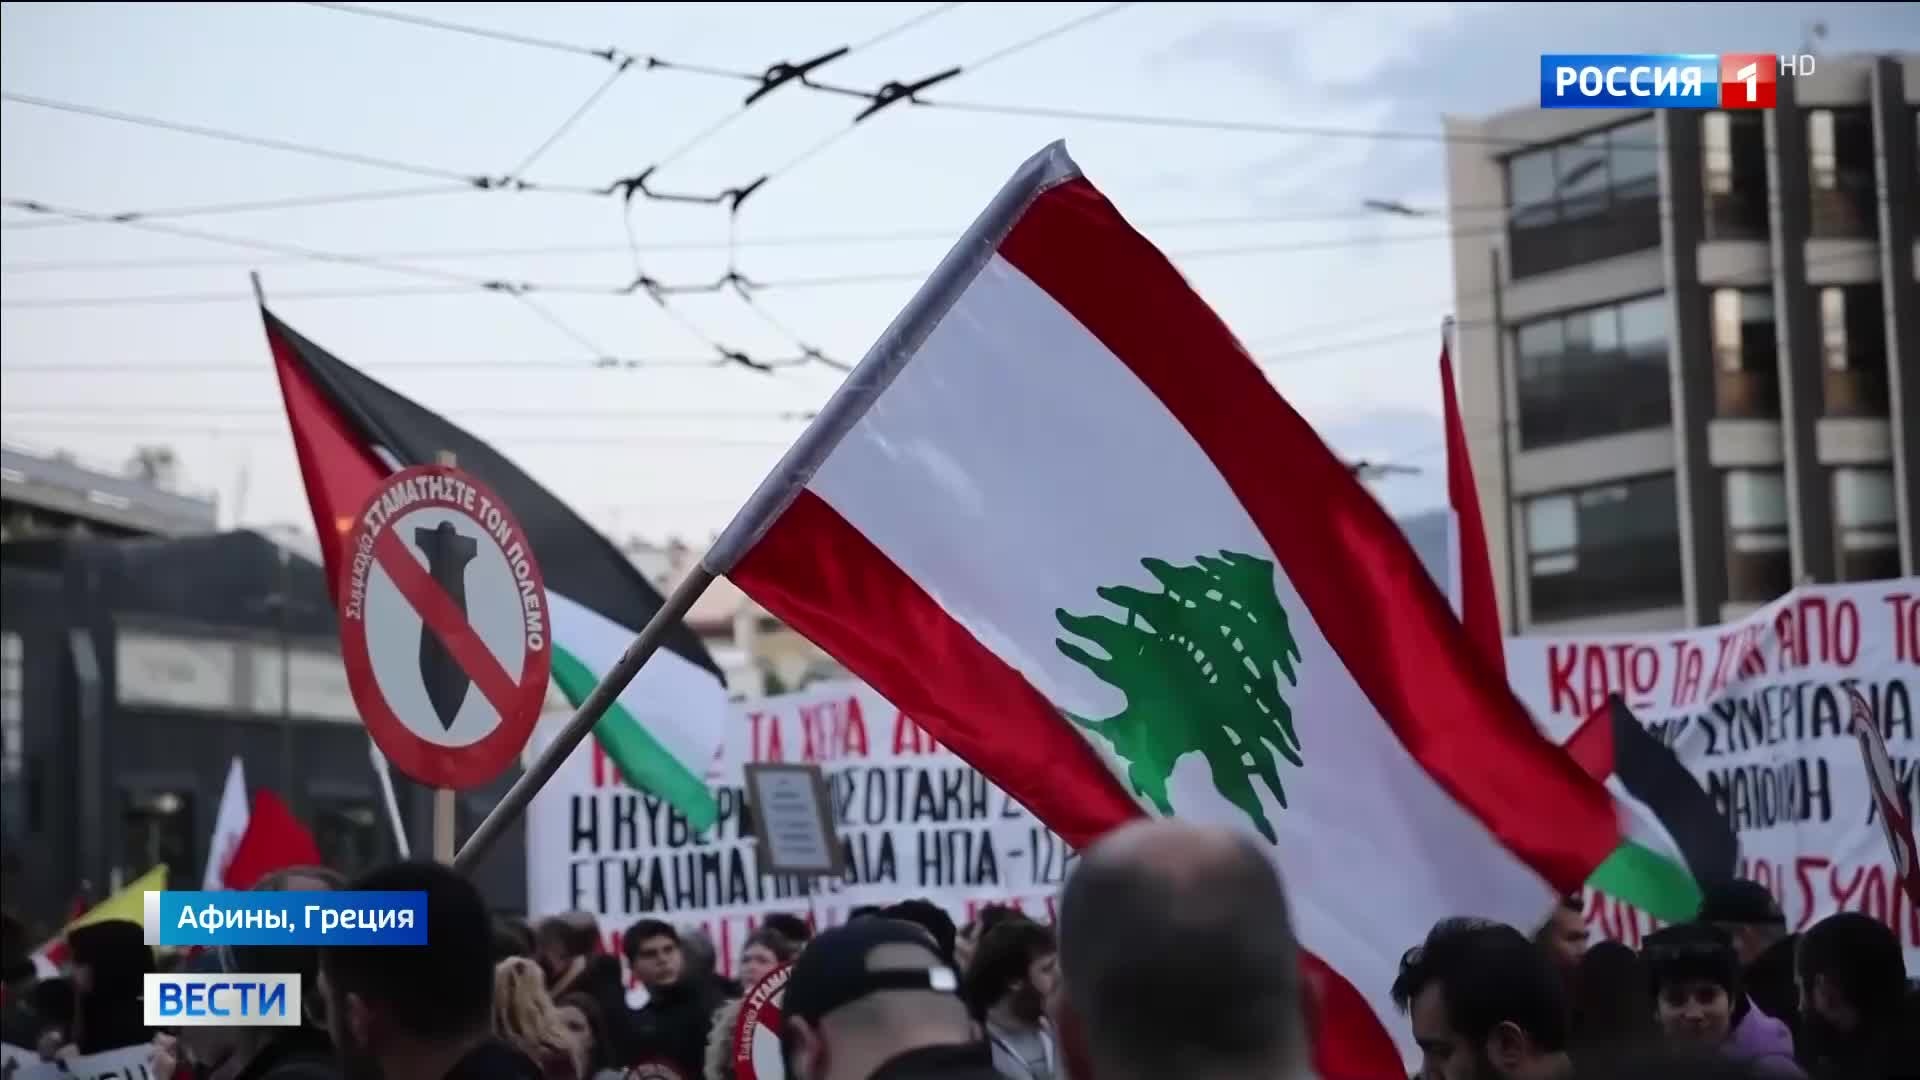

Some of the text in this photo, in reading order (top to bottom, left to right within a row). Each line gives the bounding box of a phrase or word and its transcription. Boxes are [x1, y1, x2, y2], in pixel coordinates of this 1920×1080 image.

[363, 475, 477, 536] ΣΤΑΜΑΤΗΣΤΕ
[479, 495, 513, 546] ΤΟΝ
[506, 541, 544, 652] ΠΟΛΕΜΟ
[1775, 597, 1861, 670] ΑΠΟ
[571, 795, 597, 853] Η
[826, 765, 987, 826] ΣΟΤΑΚΗ
